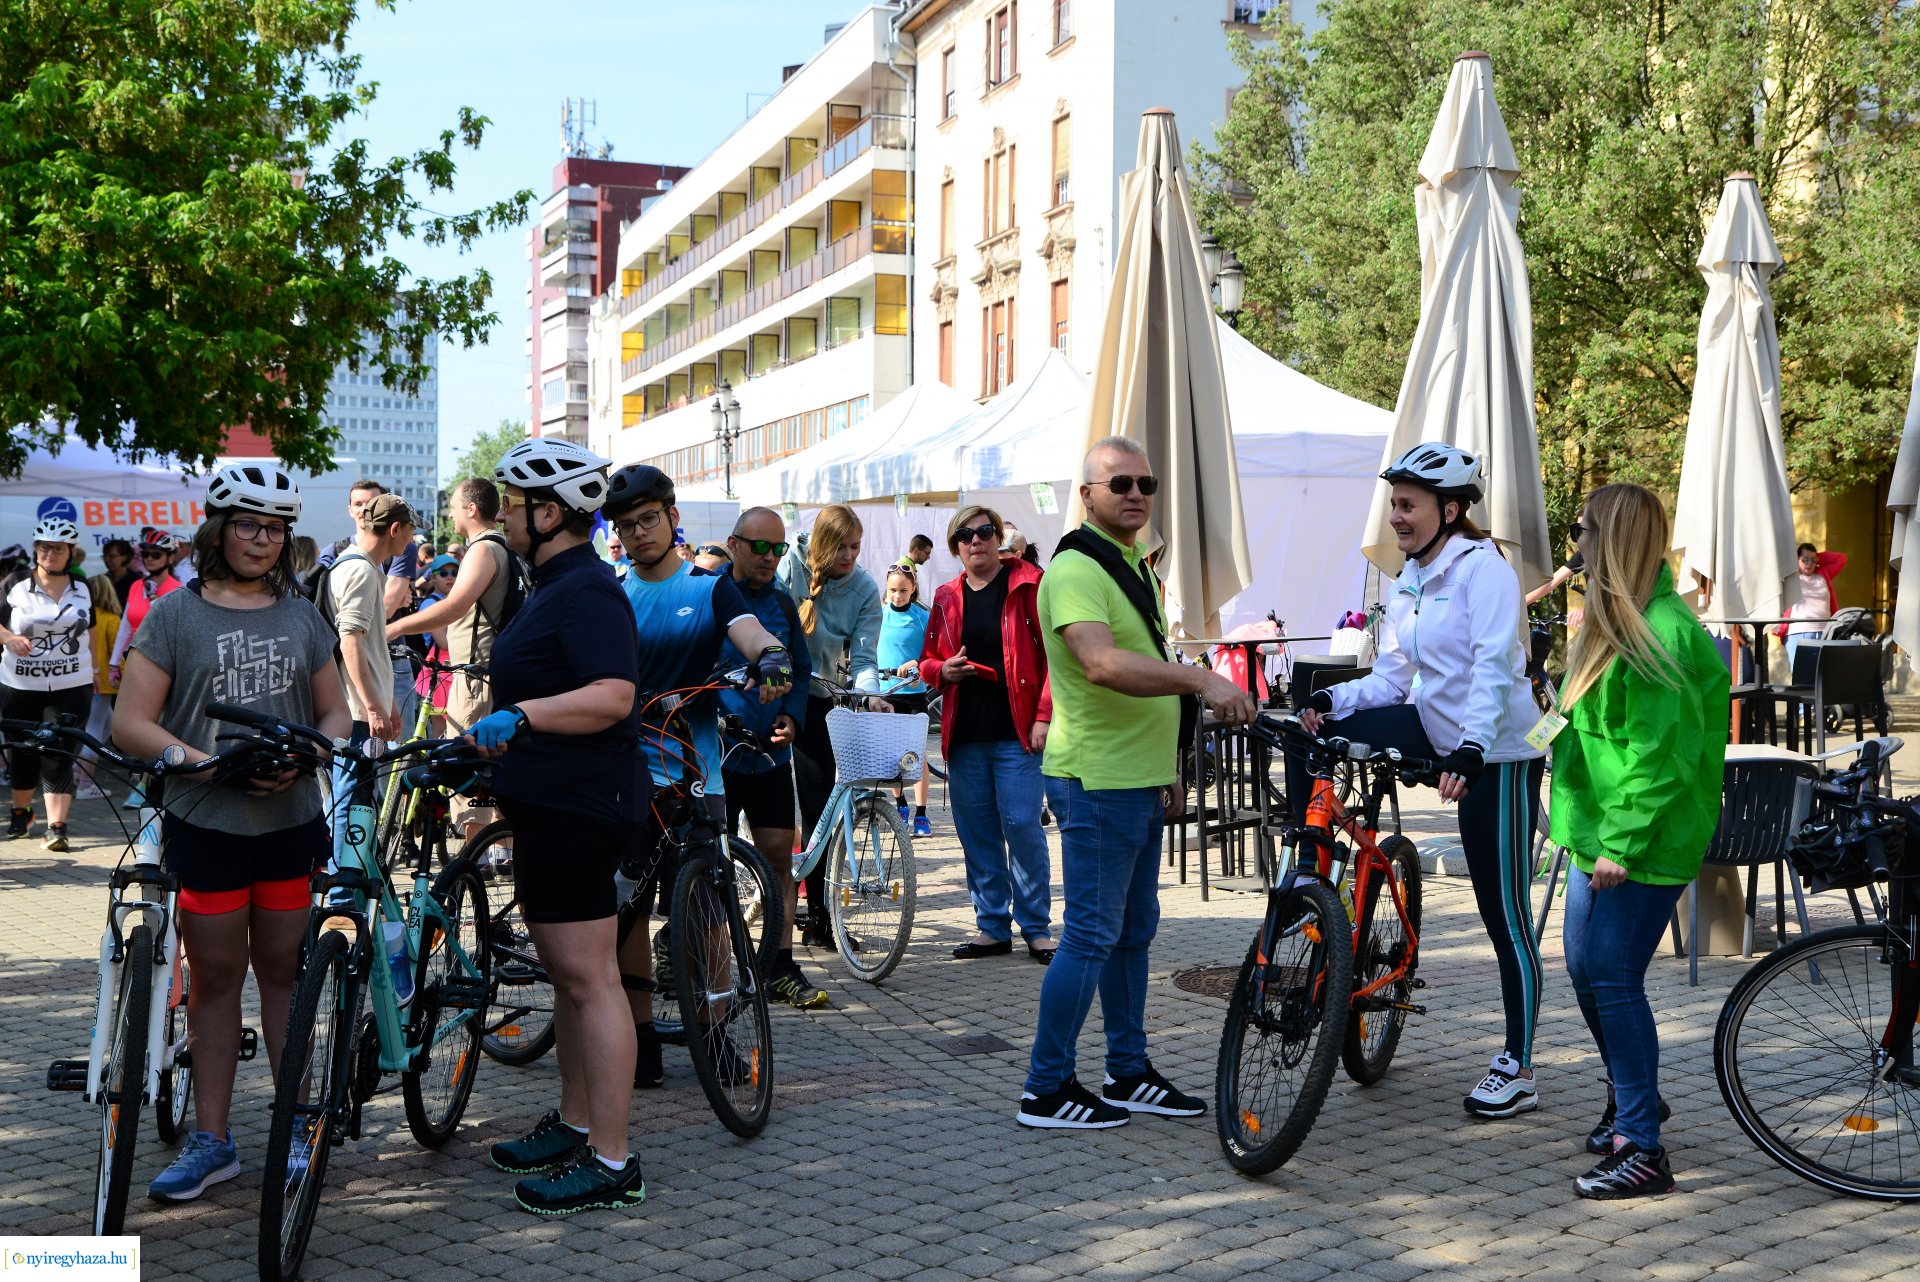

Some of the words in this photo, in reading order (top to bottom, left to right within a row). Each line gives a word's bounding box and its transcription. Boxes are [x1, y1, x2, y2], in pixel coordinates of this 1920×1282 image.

[16, 658, 40, 667] DON'T
[42, 659, 68, 667] TOUCH
[15, 662, 80, 677] BICYCLE
